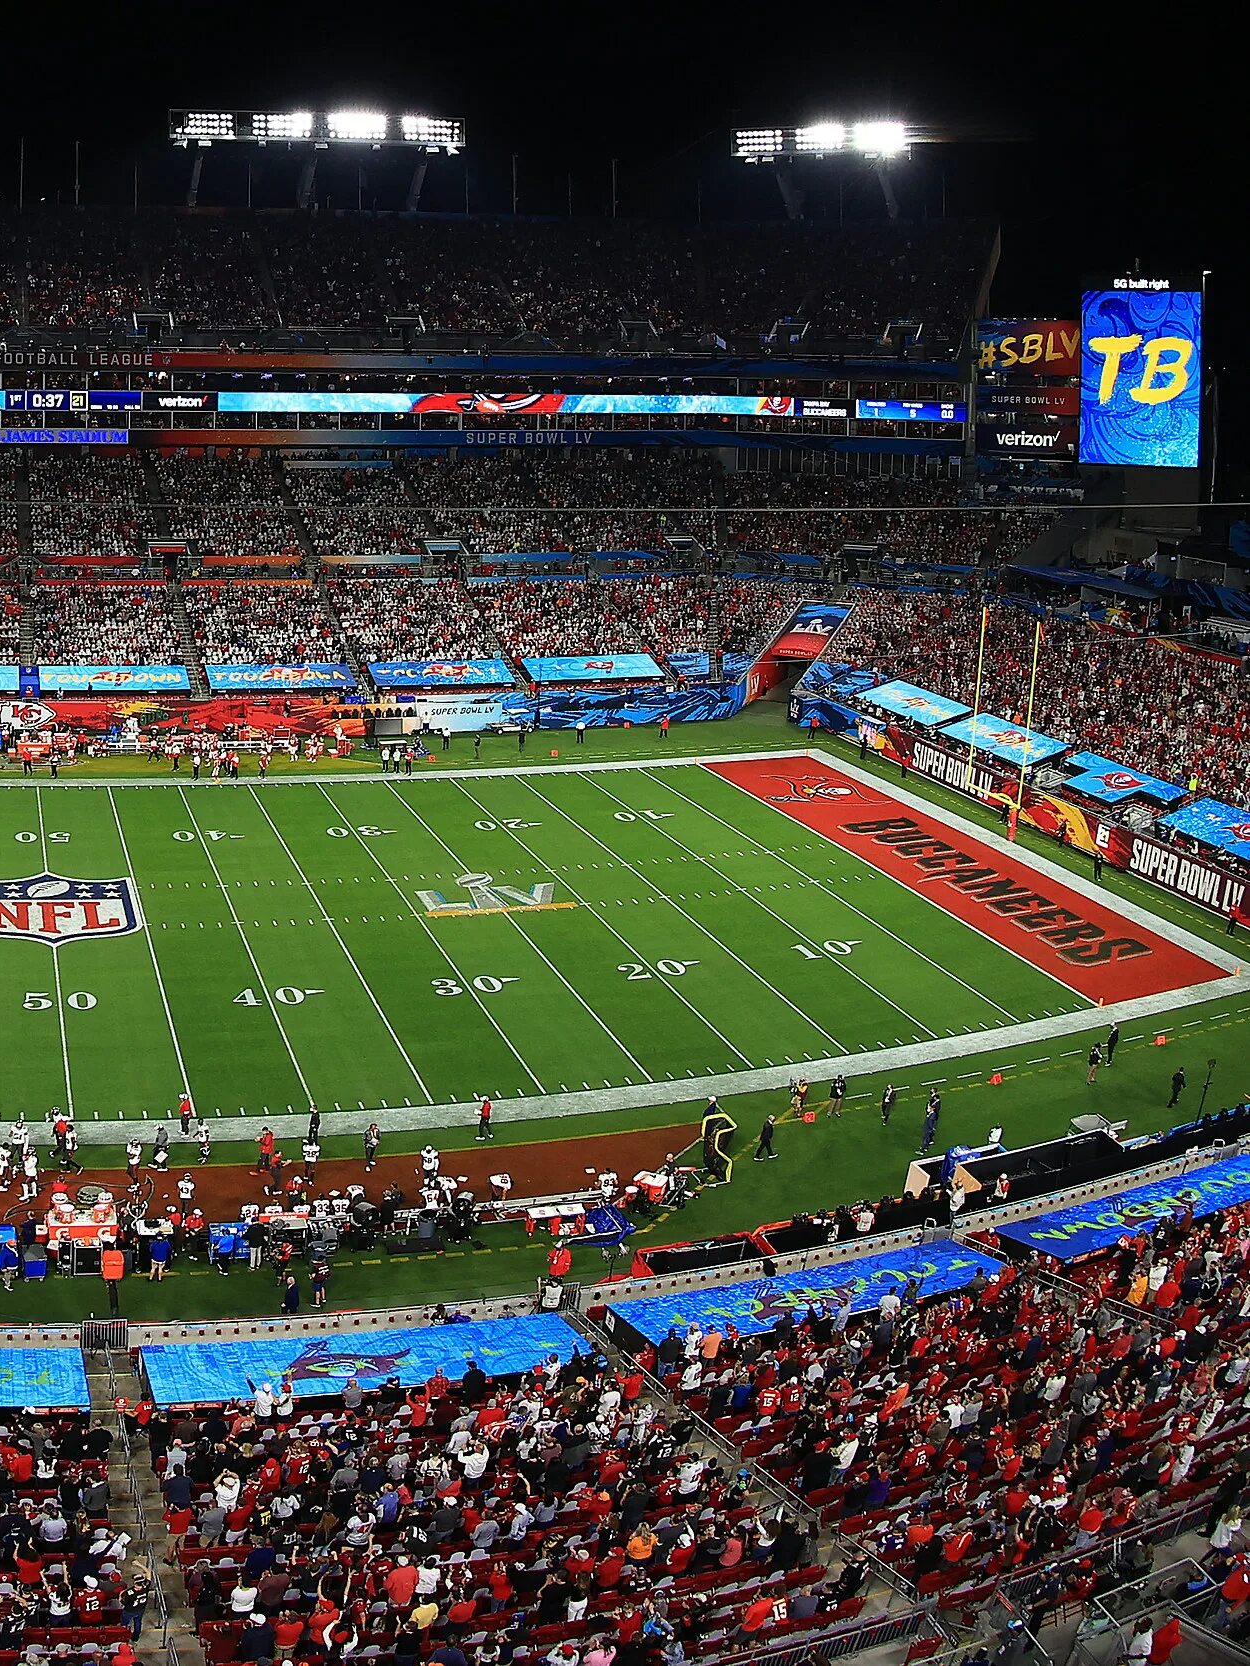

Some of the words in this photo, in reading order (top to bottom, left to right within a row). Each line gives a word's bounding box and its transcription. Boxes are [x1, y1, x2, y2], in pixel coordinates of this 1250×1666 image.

[1113, 279, 1128, 289] 5G
[1128, 279, 1148, 289] built
[1148, 279, 1169, 290] right
[978, 329, 1080, 369] #SBLV
[90, 353, 153, 366] LEAGUE
[1089, 334, 1193, 406] TB
[32, 394, 64, 407] 0:37
[72, 395, 84, 407] 21
[158, 395, 202, 408] verizon
[991, 395, 1021, 404] SUPER
[1025, 396, 1051, 404] BOWL
[1054, 397, 1065, 405] LV
[1, 429, 54, 443] JAMES
[58, 429, 128, 443] STADIUM
[466, 431, 518, 444] SUPER
[525, 431, 568, 444] BOWL
[575, 431, 592, 444] LV
[996, 431, 1053, 447] verizon
[43, 671, 182, 685] TOUCHDOWN
[214, 670, 346, 684] TOUCHDOWN
[431, 706, 456, 717] SUPER
[459, 706, 482, 716] BOWL
[484, 705, 496, 714] LV
[912, 741, 947, 780] SUPER
[613, 808, 664, 822] 10
[473, 817, 532, 831] 20
[14, 831, 71, 844] 50
[173, 829, 227, 842] 40
[326, 825, 382, 838] 30
[1129, 838, 1179, 887] SUPER
[1176, 862, 1222, 907] BOWL
[838, 817, 1152, 967] BUCCANEERS
[791, 939, 855, 961] 10
[617, 957, 687, 982] 20
[431, 975, 504, 997] 30
[22, 990, 98, 1010] 50
[232, 985, 306, 1008] 40
[317, 1203, 328, 1213] 33
[1041, 1323, 1050, 1332] 12
[762, 1397, 773, 1407] 15
[790, 1393, 800, 1401] 12
[300, 1463, 309, 1474] 12
[84, 1600, 99, 1611] 12
[772, 1602, 787, 1621] 15
